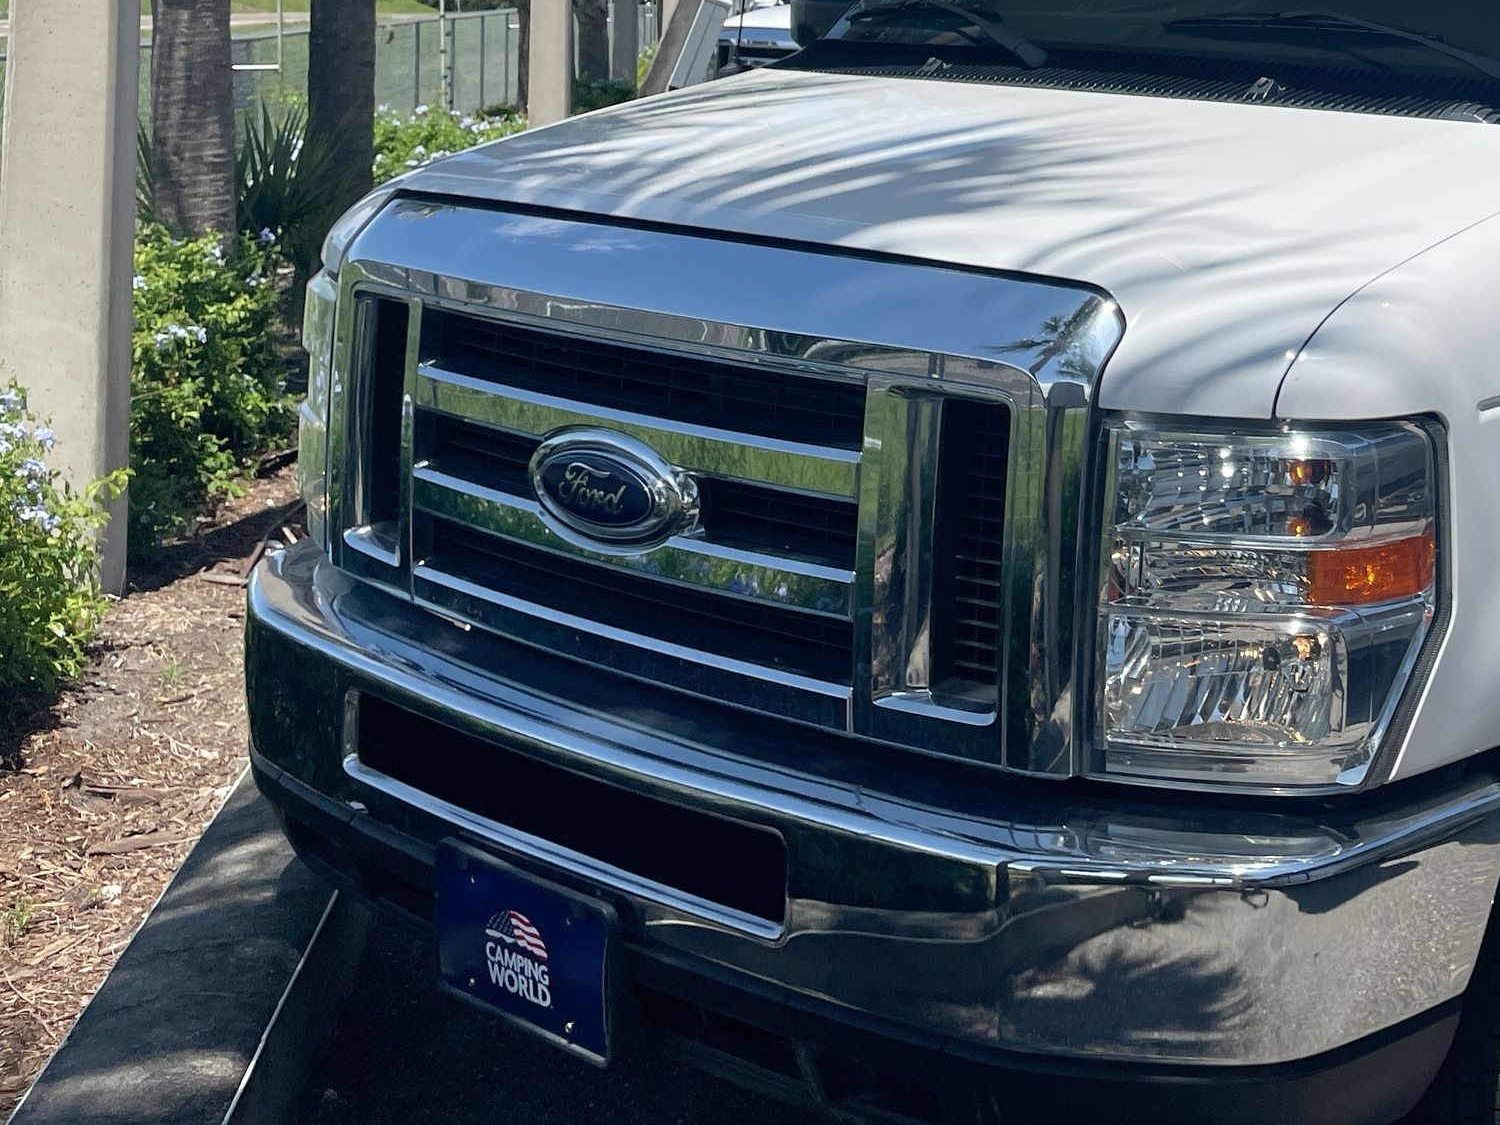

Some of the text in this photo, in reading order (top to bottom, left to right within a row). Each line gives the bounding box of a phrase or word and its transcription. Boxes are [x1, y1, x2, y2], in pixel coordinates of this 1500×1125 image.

[558, 461, 627, 515] Ford
[485, 941, 550, 986] CAMPING
[487, 959, 552, 1008] WORLD
